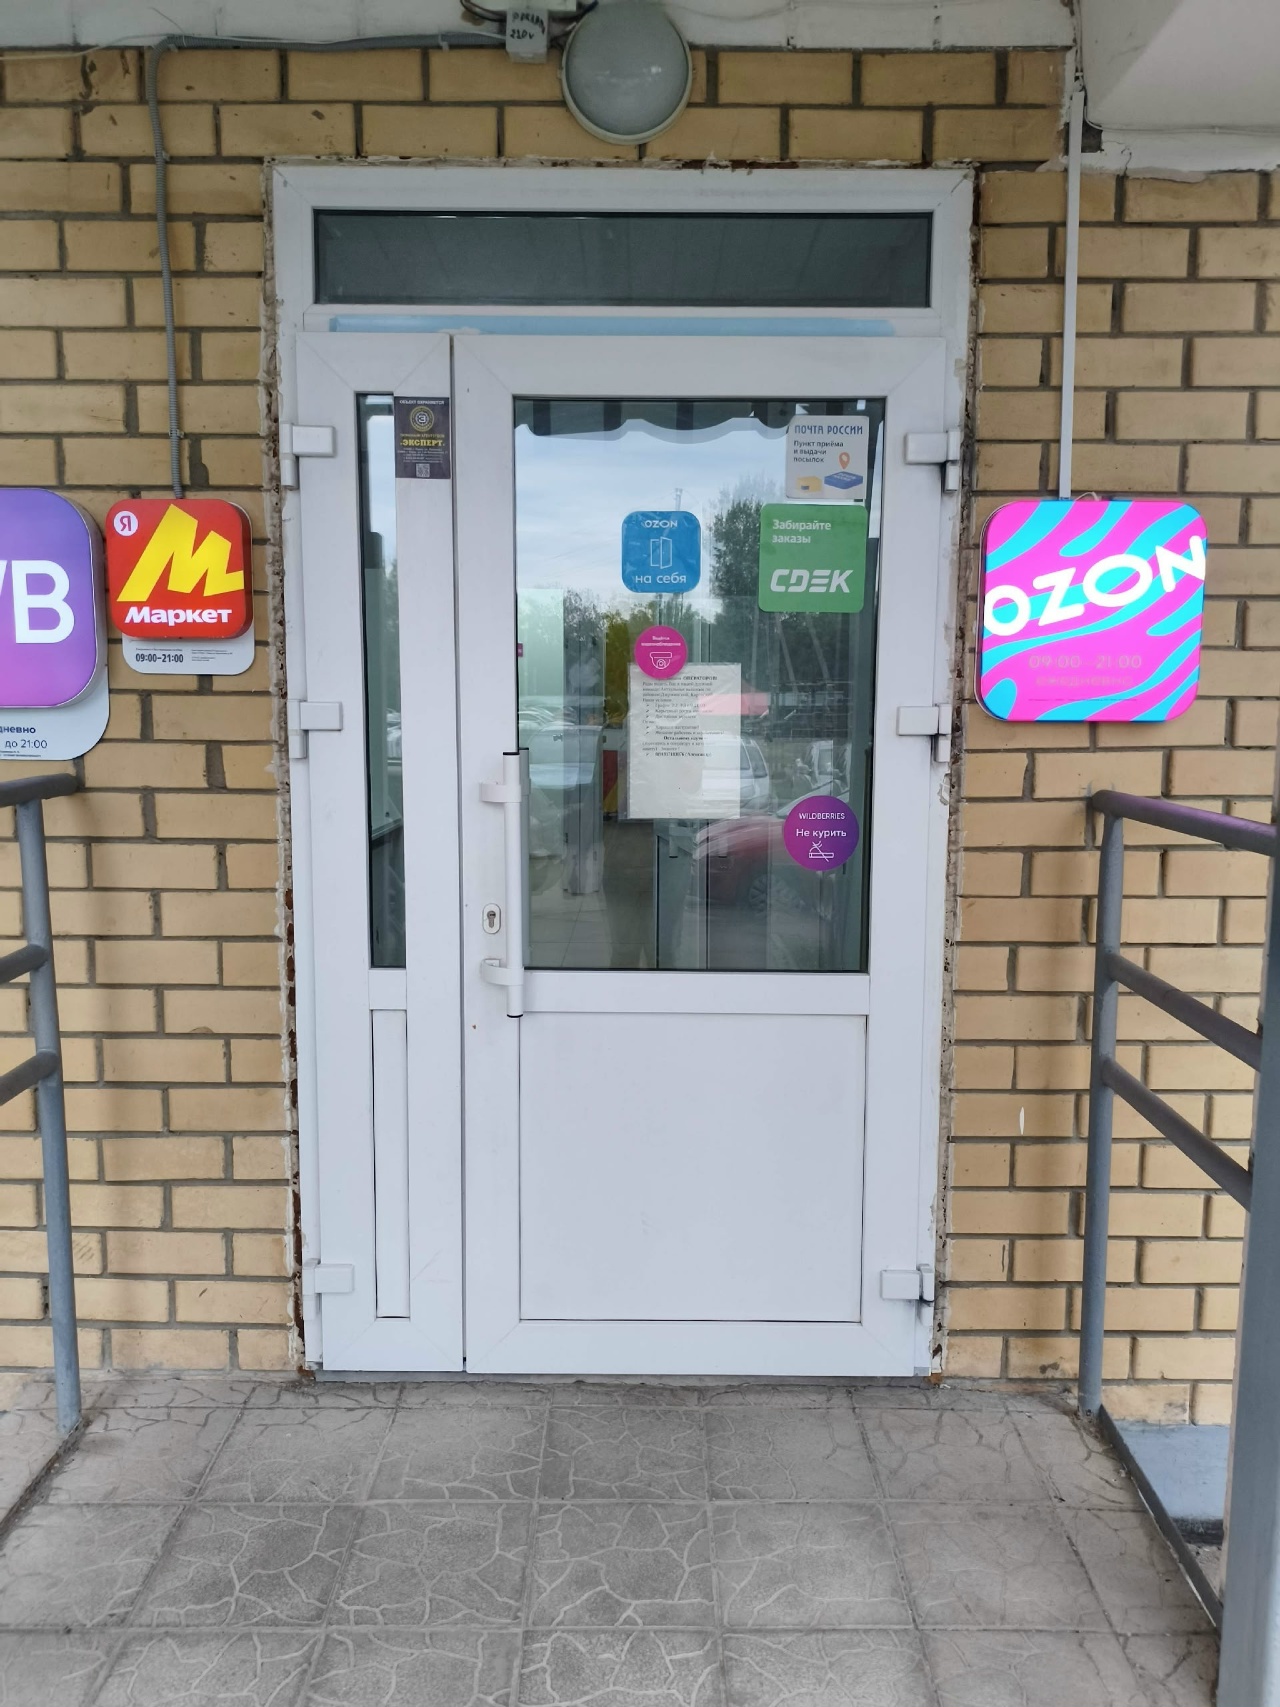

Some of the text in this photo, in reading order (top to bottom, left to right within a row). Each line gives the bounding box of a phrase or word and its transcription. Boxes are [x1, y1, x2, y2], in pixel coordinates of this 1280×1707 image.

[794, 424, 863, 435] ПОЧТА РОССИИ
[794, 440, 844, 449] Пункт приёма
[120, 516, 132, 531] Я
[644, 520, 678, 528] OZON
[772, 520, 832, 531] Забирайте
[772, 535, 811, 544] заказы
[635, 572, 686, 583] на себя
[984, 535, 1206, 636] OZON
[124, 606, 233, 626] Маркет
[5, 739, 48, 749] до 21:00
[796, 829, 847, 839] Не курить
